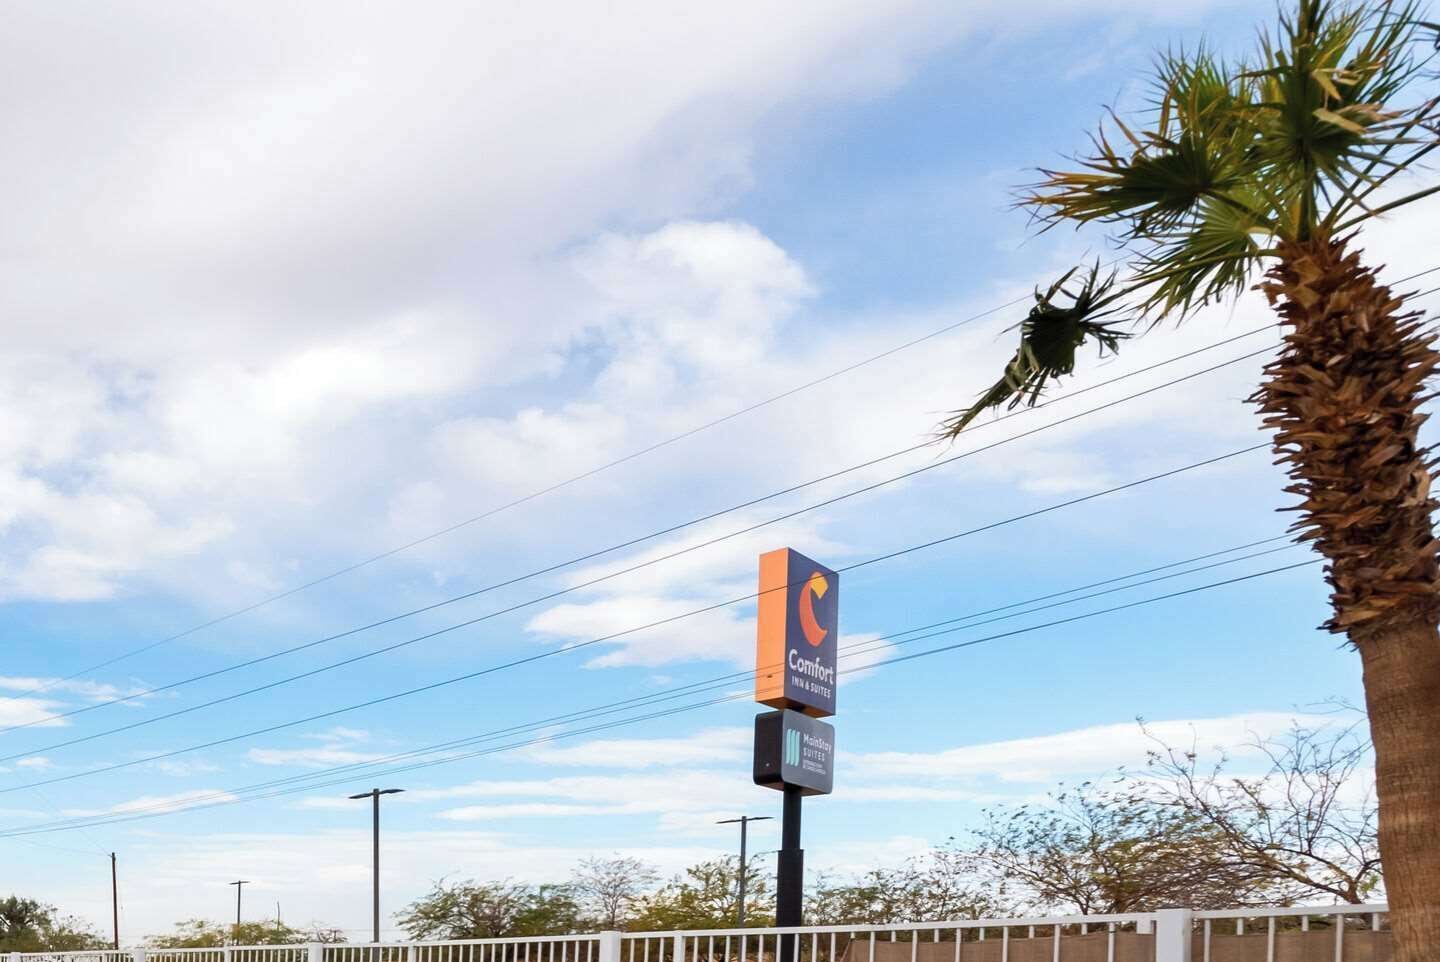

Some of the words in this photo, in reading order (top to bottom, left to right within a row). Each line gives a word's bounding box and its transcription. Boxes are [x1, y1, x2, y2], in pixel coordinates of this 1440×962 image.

[789, 649, 833, 685] Comfort
[792, 676, 804, 688] INN
[810, 683, 831, 699] SUITES
[803, 733, 832, 754] MainStay
[803, 747, 825, 762] SUITES
